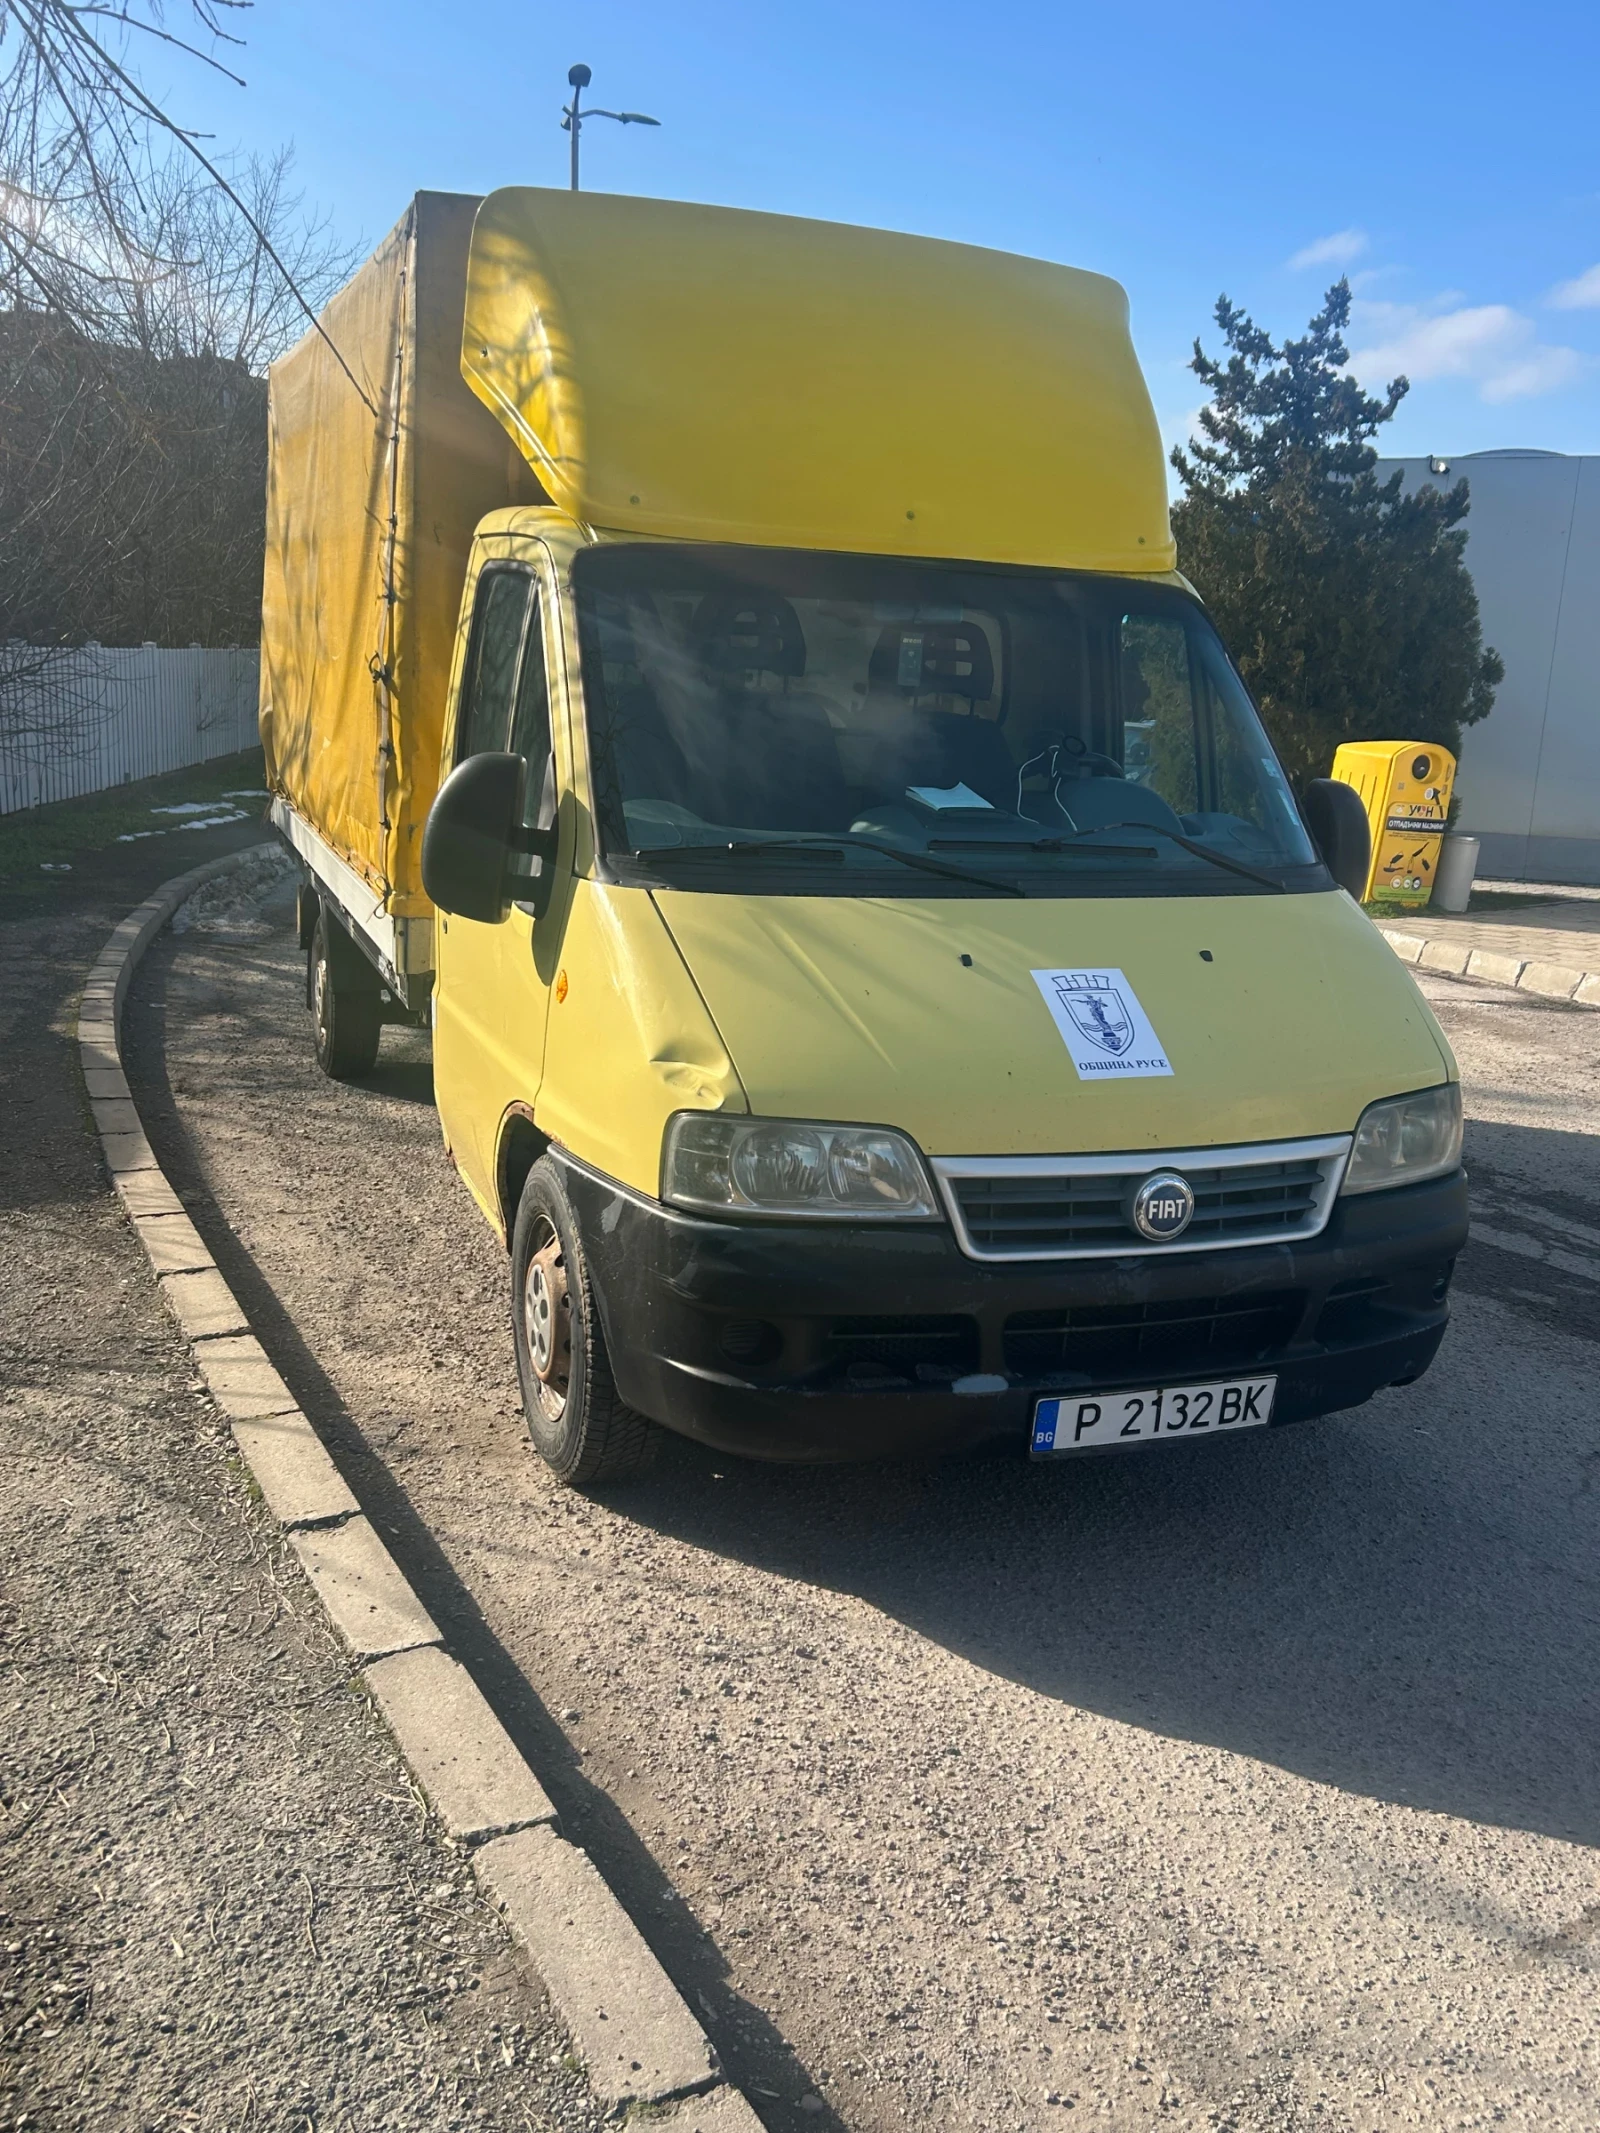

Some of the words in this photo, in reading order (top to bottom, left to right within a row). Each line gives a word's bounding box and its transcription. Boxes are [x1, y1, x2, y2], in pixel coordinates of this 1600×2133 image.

[1078, 1059, 1135, 1072] ОБЩИНА
[1135, 1058, 1168, 1069] РУСЕ
[1148, 1198, 1186, 1220] FIAT
[1035, 1431, 1054, 1444] BG
